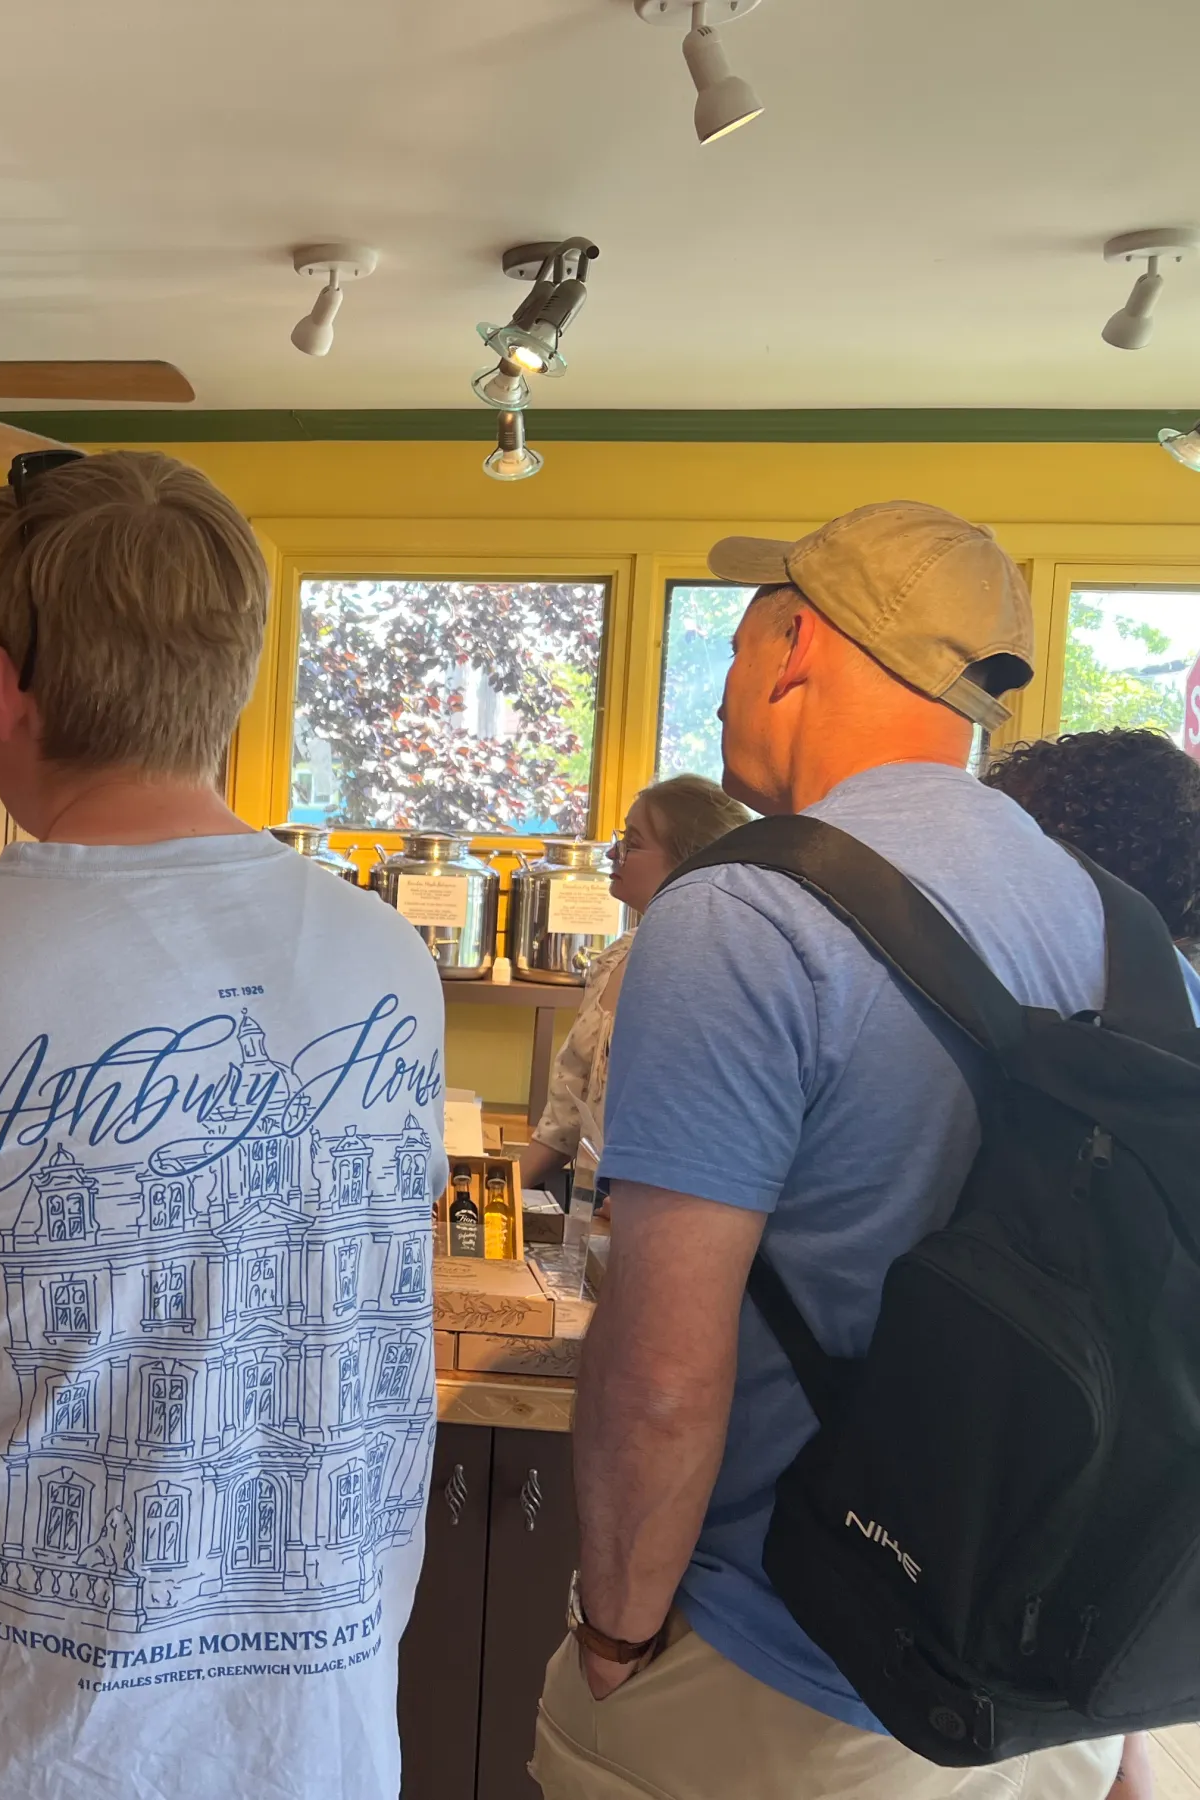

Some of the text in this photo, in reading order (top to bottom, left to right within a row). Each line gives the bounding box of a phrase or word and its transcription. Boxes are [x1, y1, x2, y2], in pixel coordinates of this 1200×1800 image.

[218, 985, 264, 998] EST. 1926
[845, 1510, 922, 1583] NIKE
[199, 1630, 328, 1655] MOMENTS
[332, 1623, 359, 1647] AT
[77, 1678, 90, 1691] 41
[93, 1676, 152, 1693] CHARLES
[154, 1668, 206, 1685] STREET,
[208, 1664, 290, 1679] GREENWICH
[294, 1658, 347, 1675] VILLAGE,
[348, 1648, 371, 1667] NEW
